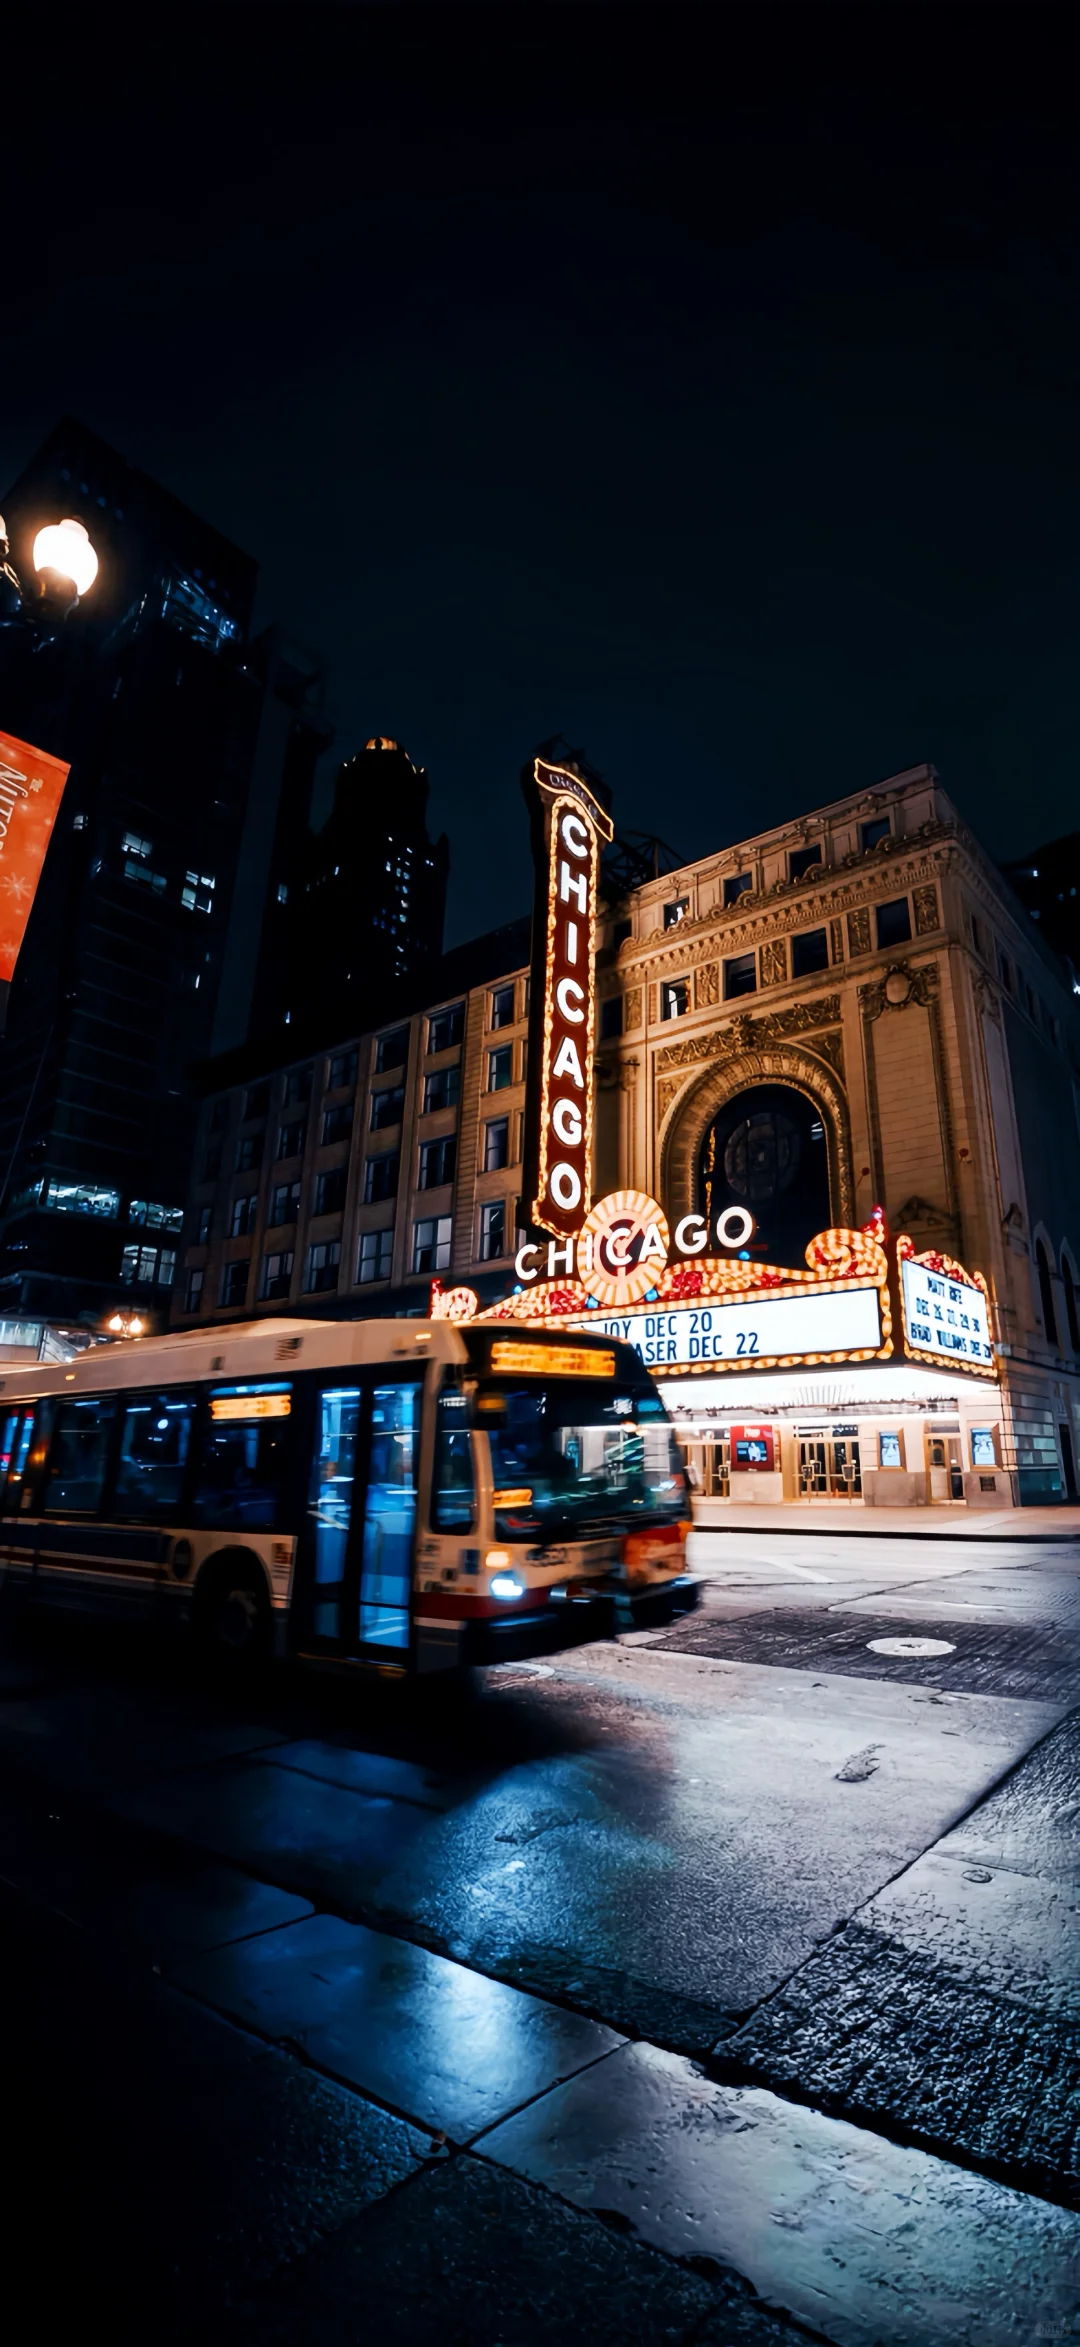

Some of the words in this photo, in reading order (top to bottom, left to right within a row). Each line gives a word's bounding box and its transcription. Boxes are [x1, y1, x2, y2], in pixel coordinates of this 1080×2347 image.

[550, 813, 588, 1210] CHICAGO
[514, 1205, 753, 1281] CHICAGO
[916, 1297, 930, 1317] DEC
[646, 1315, 677, 1338] DEC
[689, 1311, 713, 1334] 20
[635, 1339, 677, 1363] ASER
[689, 1334, 723, 1359] DEC
[736, 1331, 760, 1355] 22
